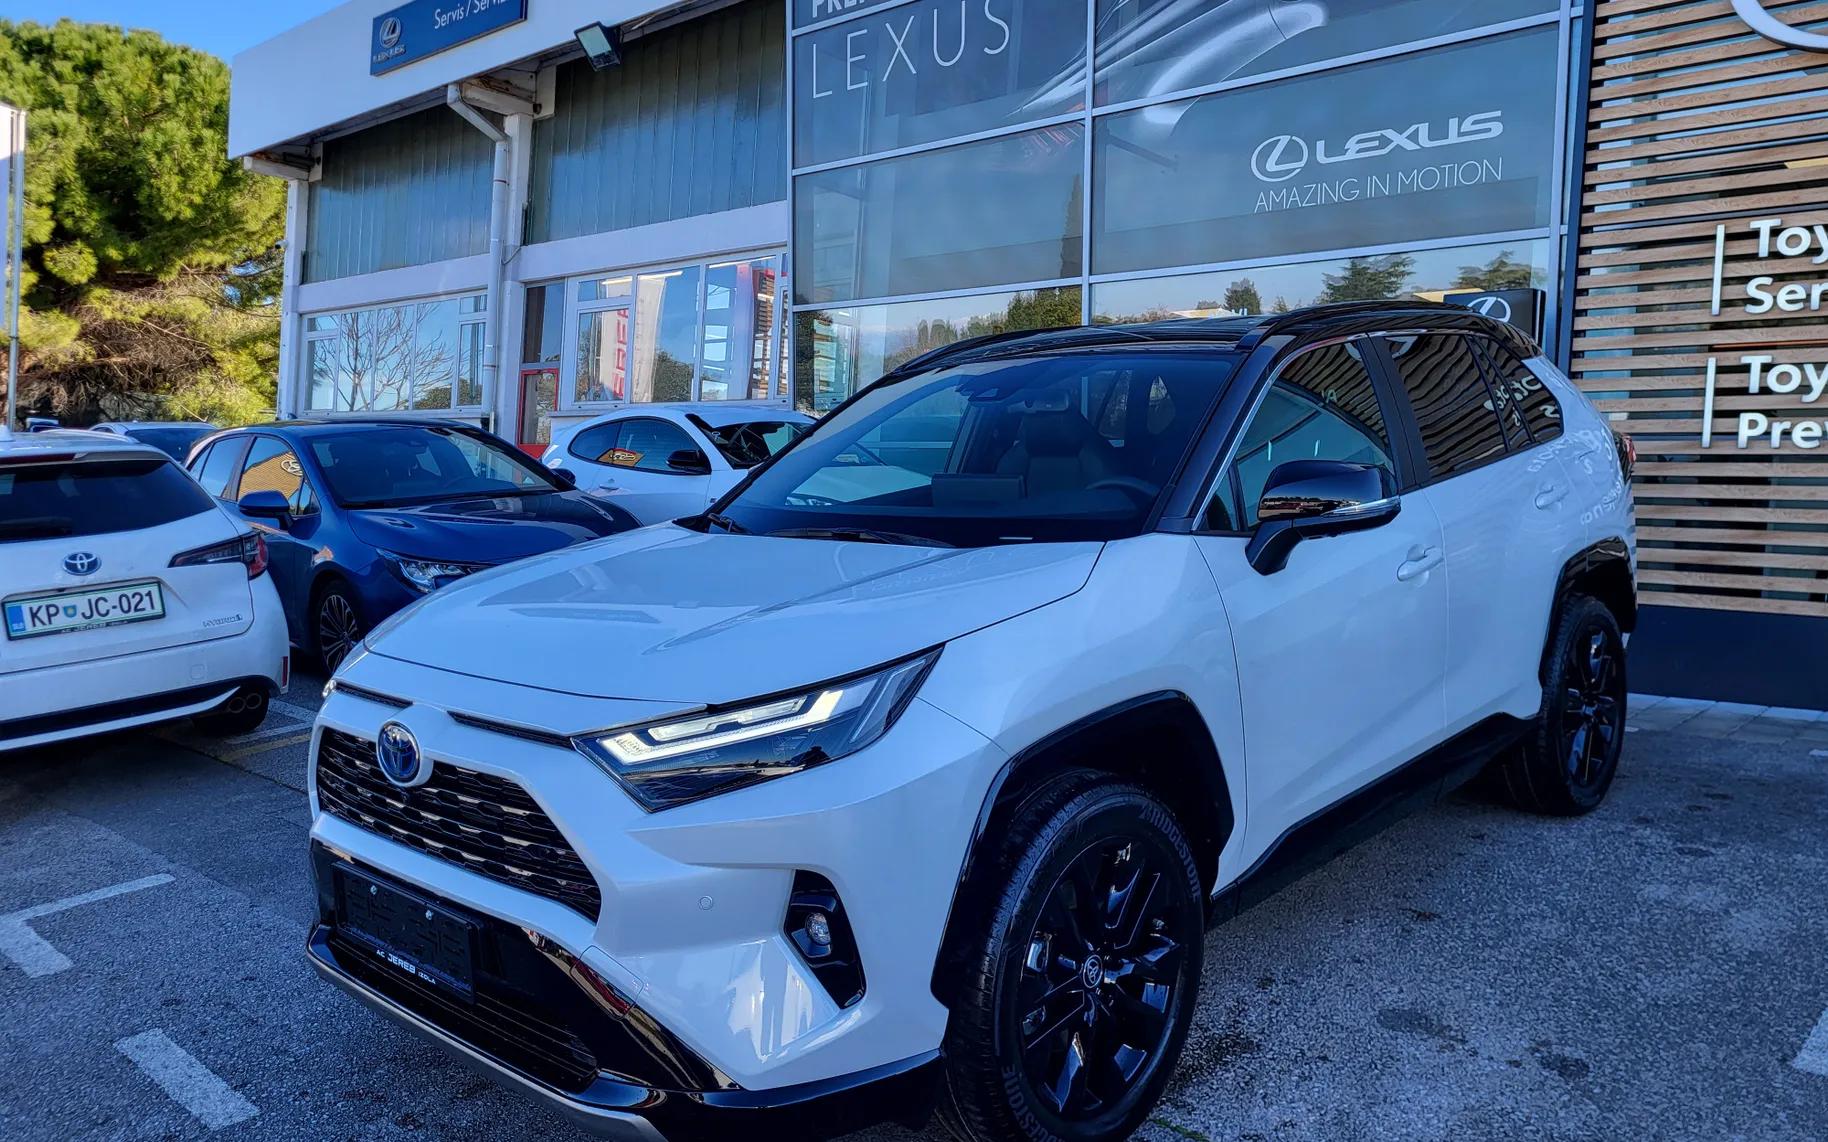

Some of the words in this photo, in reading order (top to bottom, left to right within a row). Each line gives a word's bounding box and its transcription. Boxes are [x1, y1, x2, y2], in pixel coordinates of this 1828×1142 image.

[434, 3, 464, 29] Servis
[812, 0, 1010, 98] LEXUS
[1316, 110, 1504, 164] LEXUS
[1254, 178, 1360, 214] AMAZING
[1367, 173, 1390, 198] IN
[1397, 157, 1503, 194] MOTION
[1737, 412, 1828, 449] Pre
[29, 603, 60, 628] KP
[81, 590, 156, 620] JC-021
[376, 949, 386, 958] AC
[387, 953, 416, 975] JEREB
